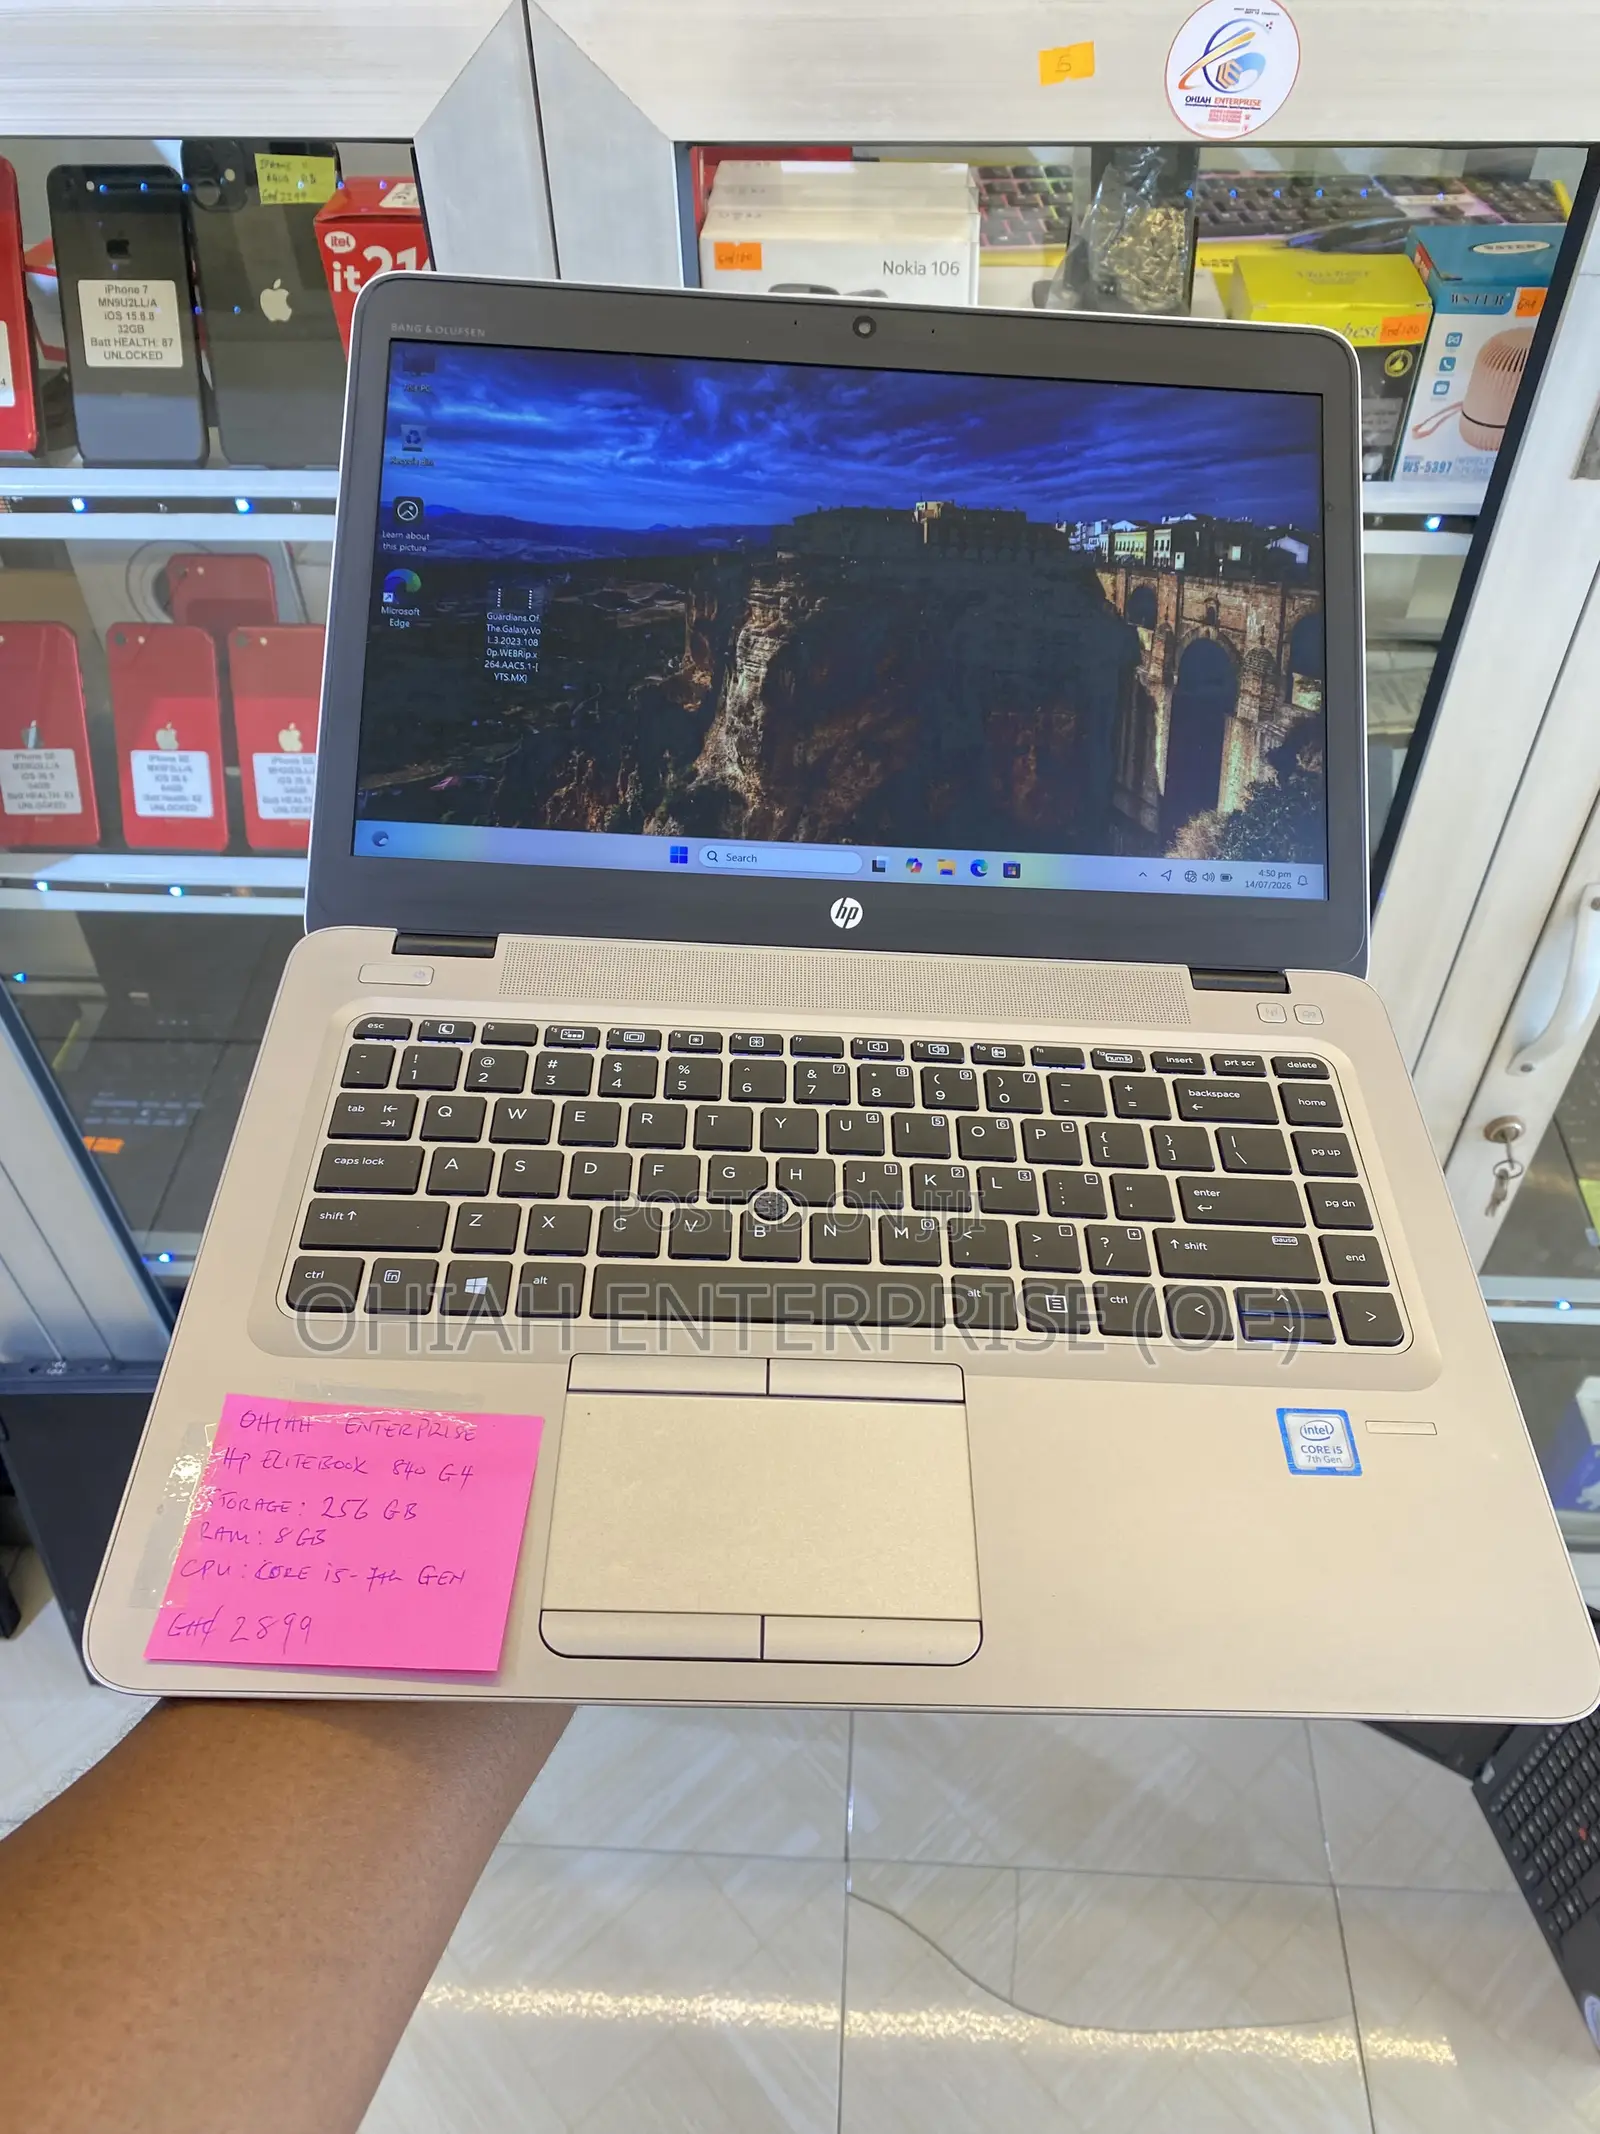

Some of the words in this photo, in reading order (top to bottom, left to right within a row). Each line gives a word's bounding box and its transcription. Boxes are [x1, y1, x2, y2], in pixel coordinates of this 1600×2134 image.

[1185, 95, 1212, 104] OHIAH
[1214, 96, 1262, 107] ENTERPRISE
[330, 234, 351, 249] itel
[882, 260, 927, 276] Nokia
[931, 261, 960, 276] 106
[104, 284, 140, 294] iPhone
[142, 284, 149, 294] 7
[104, 311, 123, 321] iOS
[391, 322, 422, 333] BANG
[425, 324, 433, 333] &
[434, 325, 486, 337] OLUFSEN
[90, 337, 112, 347] Batt
[103, 350, 163, 360] UNLOCKED
[382, 530, 403, 539] Learn
[405, 530, 430, 541] about
[382, 542, 398, 551] this
[399, 543, 428, 553] picture
[381, 606, 421, 616] Microsoft
[389, 618, 411, 629] Edge
[726, 852, 758, 864] Search
[1258, 868, 1276, 878] 4:50
[1277, 870, 1292, 880] pm
[1245, 880, 1292, 890] 14/07/2026
[831, 897, 863, 929] hp
[367, 1021, 385, 1031] esc
[1165, 1055, 1194, 1065] insert
[1224, 1058, 1239, 1068] prt
[1241, 1059, 1256, 1067] scr
[1287, 1060, 1318, 1070] delete
[411, 1070, 417, 1080] 1
[478, 1072, 488, 1083] 2
[545, 1075, 556, 1086] 3
[611, 1078, 622, 1088] 4
[677, 1081, 687, 1090] 5
[742, 1083, 752, 1092] 6
[806, 1084, 817, 1095] 7
[871, 1087, 882, 1097] 8
[935, 1089, 946, 1101] 9
[1188, 1089, 1241, 1099] backspace
[1298, 1098, 1327, 1107] home
[347, 1104, 365, 1113] tab
[437, 1105, 453, 1118] Q
[508, 1108, 527, 1120] W
[574, 1110, 586, 1122] E
[641, 1113, 654, 1124] R
[707, 1115, 719, 1126] T
[775, 1117, 787, 1128] Y
[840, 1119, 852, 1131] U
[971, 1126, 985, 1138] O
[1035, 1129, 1047, 1140] P
[1311, 1148, 1325, 1158] pg
[1327, 1148, 1341, 1158] up
[334, 1156, 360, 1166] caps
[362, 1157, 385, 1166] lock
[444, 1157, 459, 1170] A
[514, 1159, 527, 1172] S
[584, 1162, 598, 1174] D
[653, 1164, 665, 1176] F
[722, 1166, 736, 1179] G
[790, 1168, 803, 1180] H
[856, 1172, 866, 1183] J
[924, 1174, 937, 1186] K
[992, 1177, 1003, 1189] L
[1193, 1188, 1221, 1198] enter
[1325, 1199, 1340, 1209] pg
[1341, 1198, 1356, 1208] dn
[319, 1210, 344, 1221] shift
[468, 1214, 484, 1227] Z
[541, 1216, 556, 1229] X
[613, 1218, 628, 1231] C
[684, 1220, 699, 1233] V
[754, 1225, 767, 1238] B
[823, 1224, 837, 1237] N
[894, 1227, 909, 1239] M
[1184, 1240, 1208, 1251] shift
[1345, 1253, 1366, 1263] end
[304, 1270, 324, 1280] ctrl
[385, 1271, 398, 1282] fn
[532, 1276, 548, 1286] alt
[967, 1288, 981, 1298] alt
[1110, 1294, 1129, 1305] ctrl
[343, 1416, 477, 1442] ENTERPRISE
[1300, 1444, 1331, 1454] CORE
[1333, 1445, 1343, 1455] i5
[1306, 1454, 1322, 1464] 7th
[1323, 1455, 1343, 1464] Gen
[391, 1458, 427, 1478] 840
[438, 1462, 475, 1489] G4
[320, 1496, 369, 1521] 256
[383, 1499, 418, 1521] GB
[274, 1526, 294, 1544] 8
[253, 1558, 309, 1582] CORE
[417, 1565, 466, 1587] GEN
[229, 1613, 314, 1656] 2899
